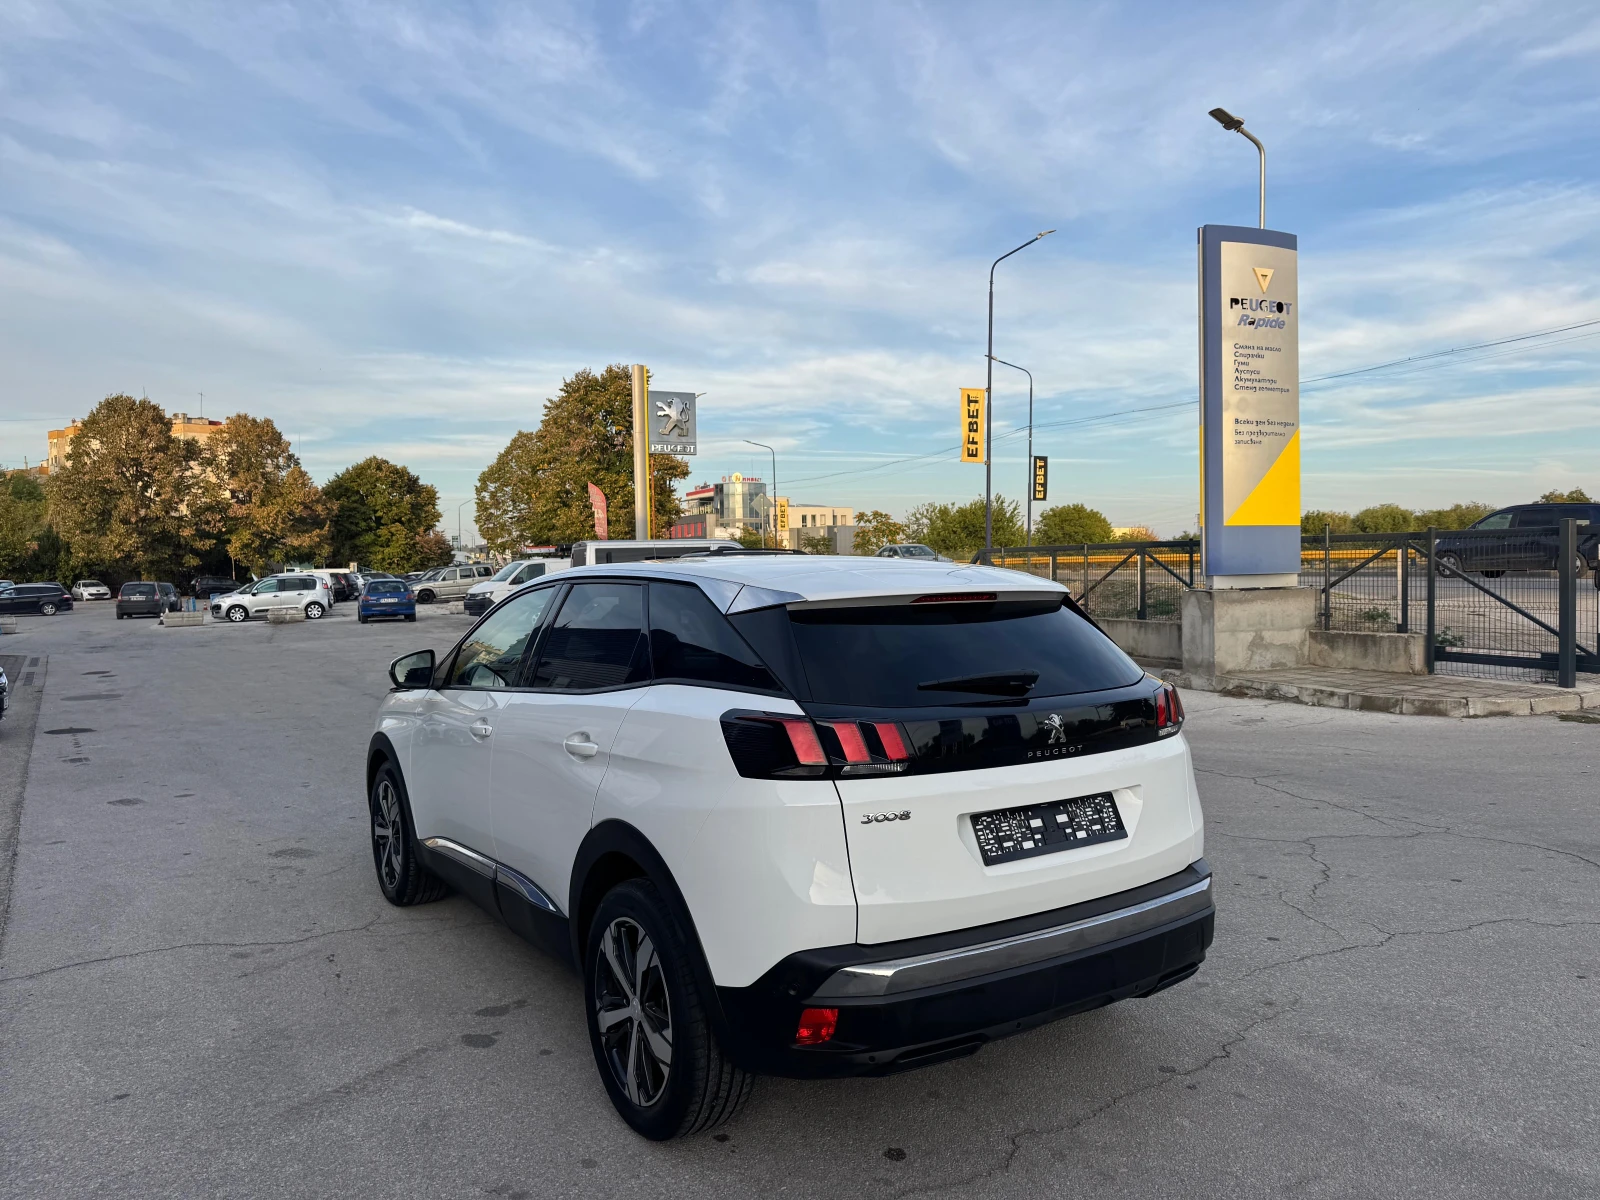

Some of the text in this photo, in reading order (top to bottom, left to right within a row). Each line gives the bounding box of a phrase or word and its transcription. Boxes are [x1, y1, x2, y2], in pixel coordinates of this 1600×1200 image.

[1230, 298, 1292, 315] PEUGEOT
[1237, 314, 1286, 329] Rapide
[1233, 343, 1255, 351] Смяна
[1233, 351, 1265, 360] Спирачки
[1233, 359, 1250, 367] Гуми
[1234, 368, 1261, 376] Ауспуси
[1234, 376, 1278, 385] Акумулатори
[1234, 384, 1257, 393] Стенд
[967, 394, 979, 458] EFBET
[651, 443, 696, 453] PEUGEOT
[1035, 459, 1045, 499] EFBET
[1027, 745, 1083, 759] PEUGEOT
[860, 810, 912, 825] 3008
